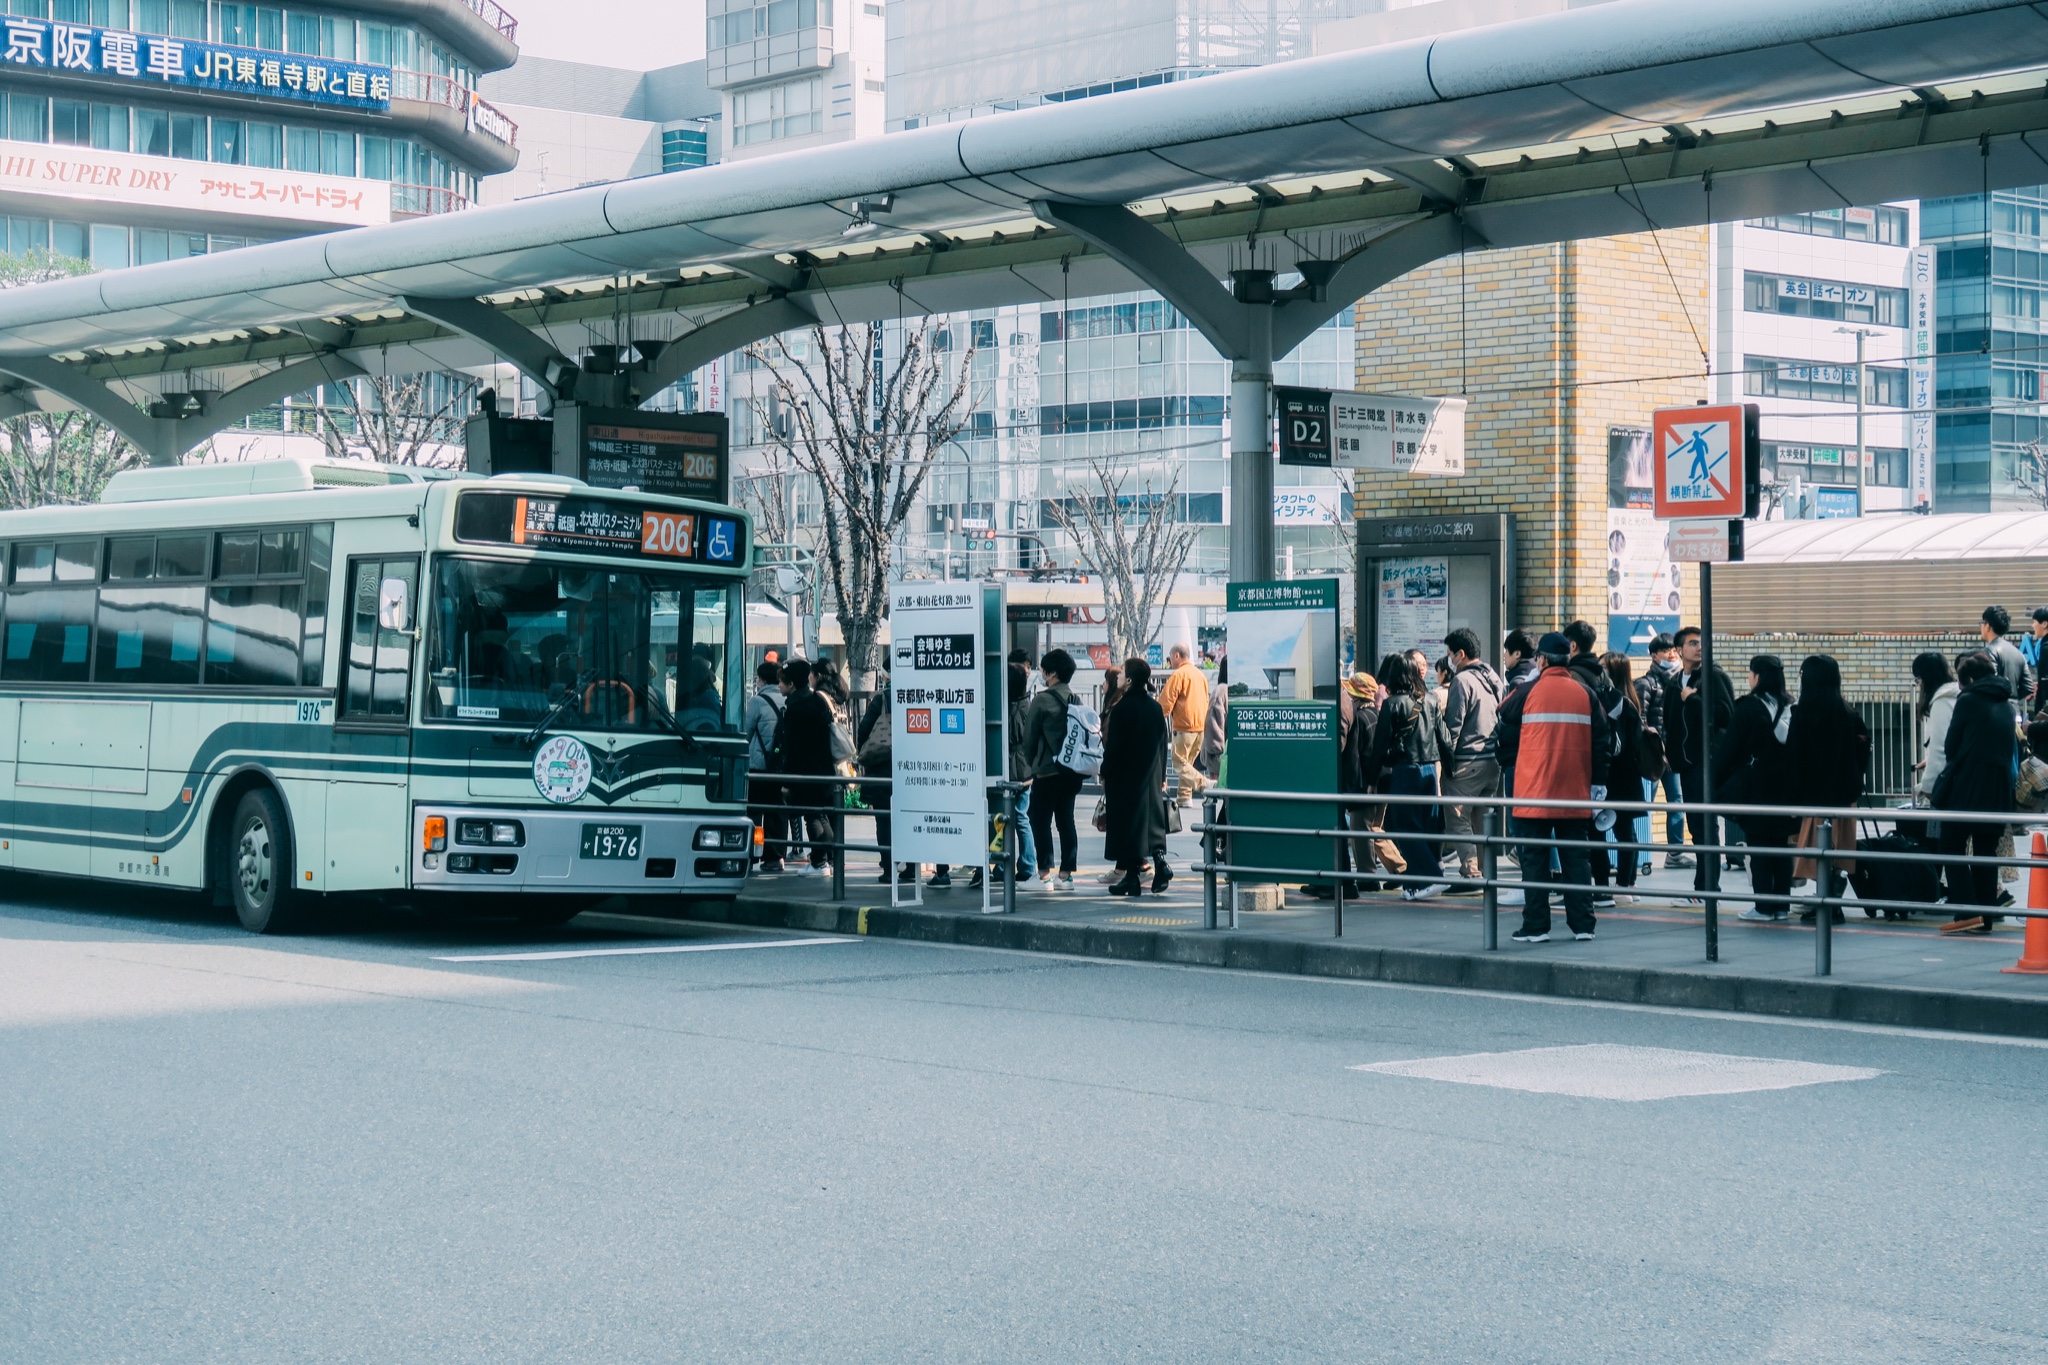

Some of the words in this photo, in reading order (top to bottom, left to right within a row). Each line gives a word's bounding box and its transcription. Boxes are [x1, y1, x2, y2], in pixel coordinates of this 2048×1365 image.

[3, 18, 186, 81] 京阪電車
[194, 51, 391, 101] JR東福寺駅と直結
[475, 103, 512, 146] KEIHAN
[0, 155, 36, 178] HI
[42, 160, 122, 187] SUPER
[128, 168, 178, 192] DRY
[200, 178, 364, 211] アサヒスーパードライ
[1917, 251, 1928, 283] TBC
[1786, 280, 1867, 302] 英会話イーオン
[710, 357, 719, 409] IT会計
[1917, 379, 1927, 408] イーオン
[1308, 404, 1326, 413] 市バス
[1338, 406, 1386, 422] 三十三間堂
[1395, 411, 1427, 425] 清水寺
[592, 427, 618, 438] 東山通
[1293, 420, 1322, 443] D2
[1338, 422, 1371, 431] Sanjusangendo
[1372, 424, 1388, 432] Temple
[589, 441, 657, 456] 博物館三十三間堂
[1339, 437, 1360, 451] 祇園
[1396, 442, 1438, 456] 京都大学
[1779, 449, 1806, 460] 大学受験
[1814, 448, 1839, 463] 研伸館
[686, 455, 715, 478] 206
[1445, 459, 1458, 468] 方面
[588, 475, 631, 484] Kiyomizu-dera
[631, 477, 651, 486] Temple
[656, 479, 674, 488] Kitaoji
[687, 481, 711, 489] Terminal
[1670, 484, 1712, 499] 横断禁止
[528, 501, 556, 512] 東山通
[527, 511, 556, 522] 三十三間堂
[526, 521, 555, 531] 清水寺
[644, 516, 690, 553] 206
[563, 537, 609, 548] Kiyomizu-dera
[611, 540, 634, 550] Temple
[1675, 542, 1722, 557] わたるな
[1382, 563, 1446, 582] 新ダイヤスタート
[1238, 586, 1301, 601] 京都国立博物館
[917, 638, 951, 652] 会場ゆき
[917, 652, 971, 667] 市バスのりば
[298, 702, 320, 721] 1976
[909, 714, 929, 728] 206
[947, 714, 958, 729] 臨
[555, 738, 586, 760] 90th
[1063, 724, 1079, 763] adidas
[536, 774, 551, 796] HAPPY
[596, 827, 624, 835] 京都200
[584, 841, 590, 849] か
[594, 835, 637, 857] 19-76
